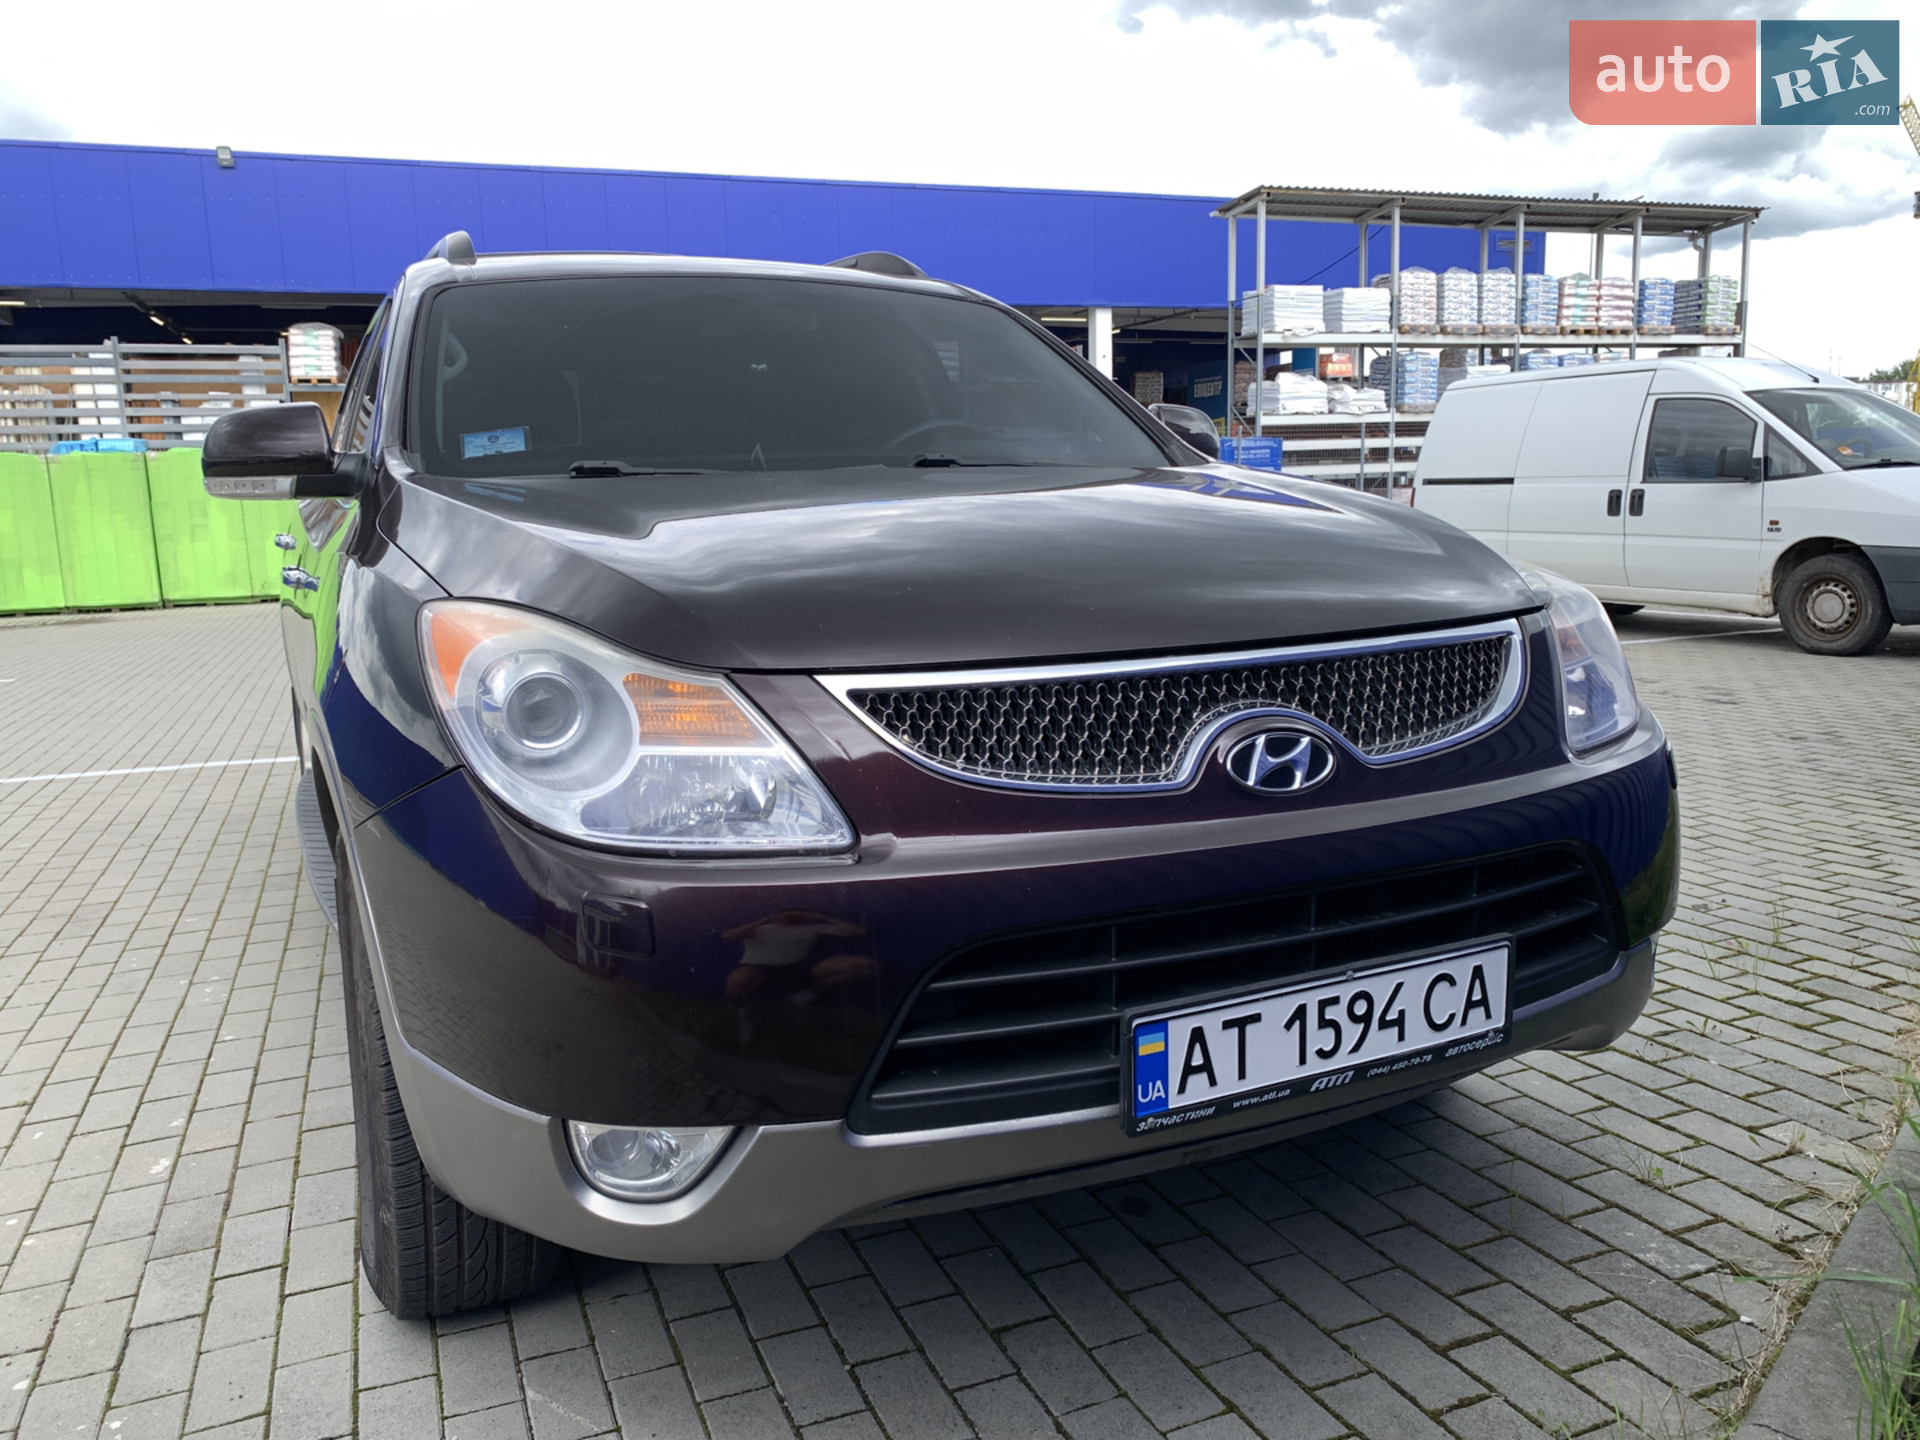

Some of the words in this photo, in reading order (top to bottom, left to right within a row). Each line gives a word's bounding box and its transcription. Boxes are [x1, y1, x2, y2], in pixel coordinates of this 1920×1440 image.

[1138, 1080, 1166, 1103] UA
[1176, 1012, 1263, 1095] AT
[1283, 981, 1405, 1066] 1594
[1423, 964, 1493, 1032] CA
